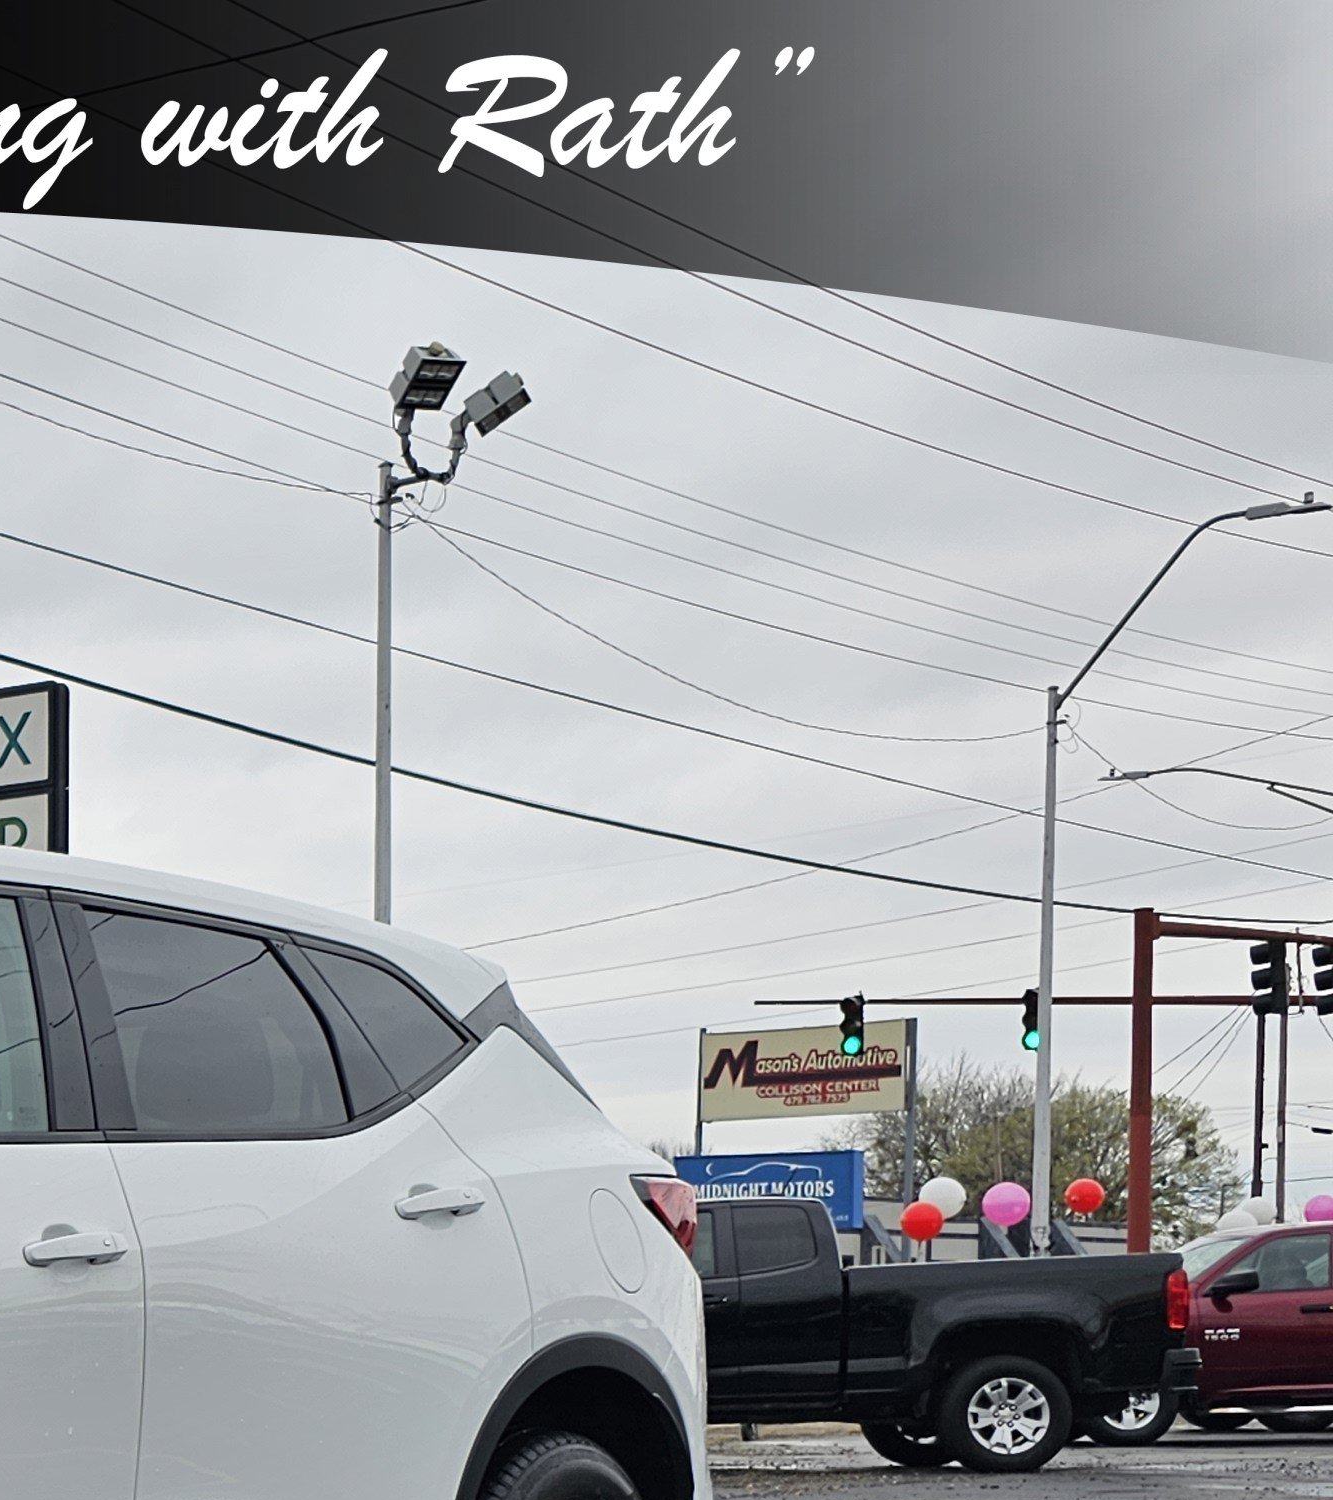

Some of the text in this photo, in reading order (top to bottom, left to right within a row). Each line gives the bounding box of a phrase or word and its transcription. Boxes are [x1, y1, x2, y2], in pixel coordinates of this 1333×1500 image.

[703, 1039, 897, 1090] Mason's Automotive
[756, 1079, 878, 1099] COLLISION CENTER
[695, 1179, 835, 1199] MIDNIGHT MOTORS
